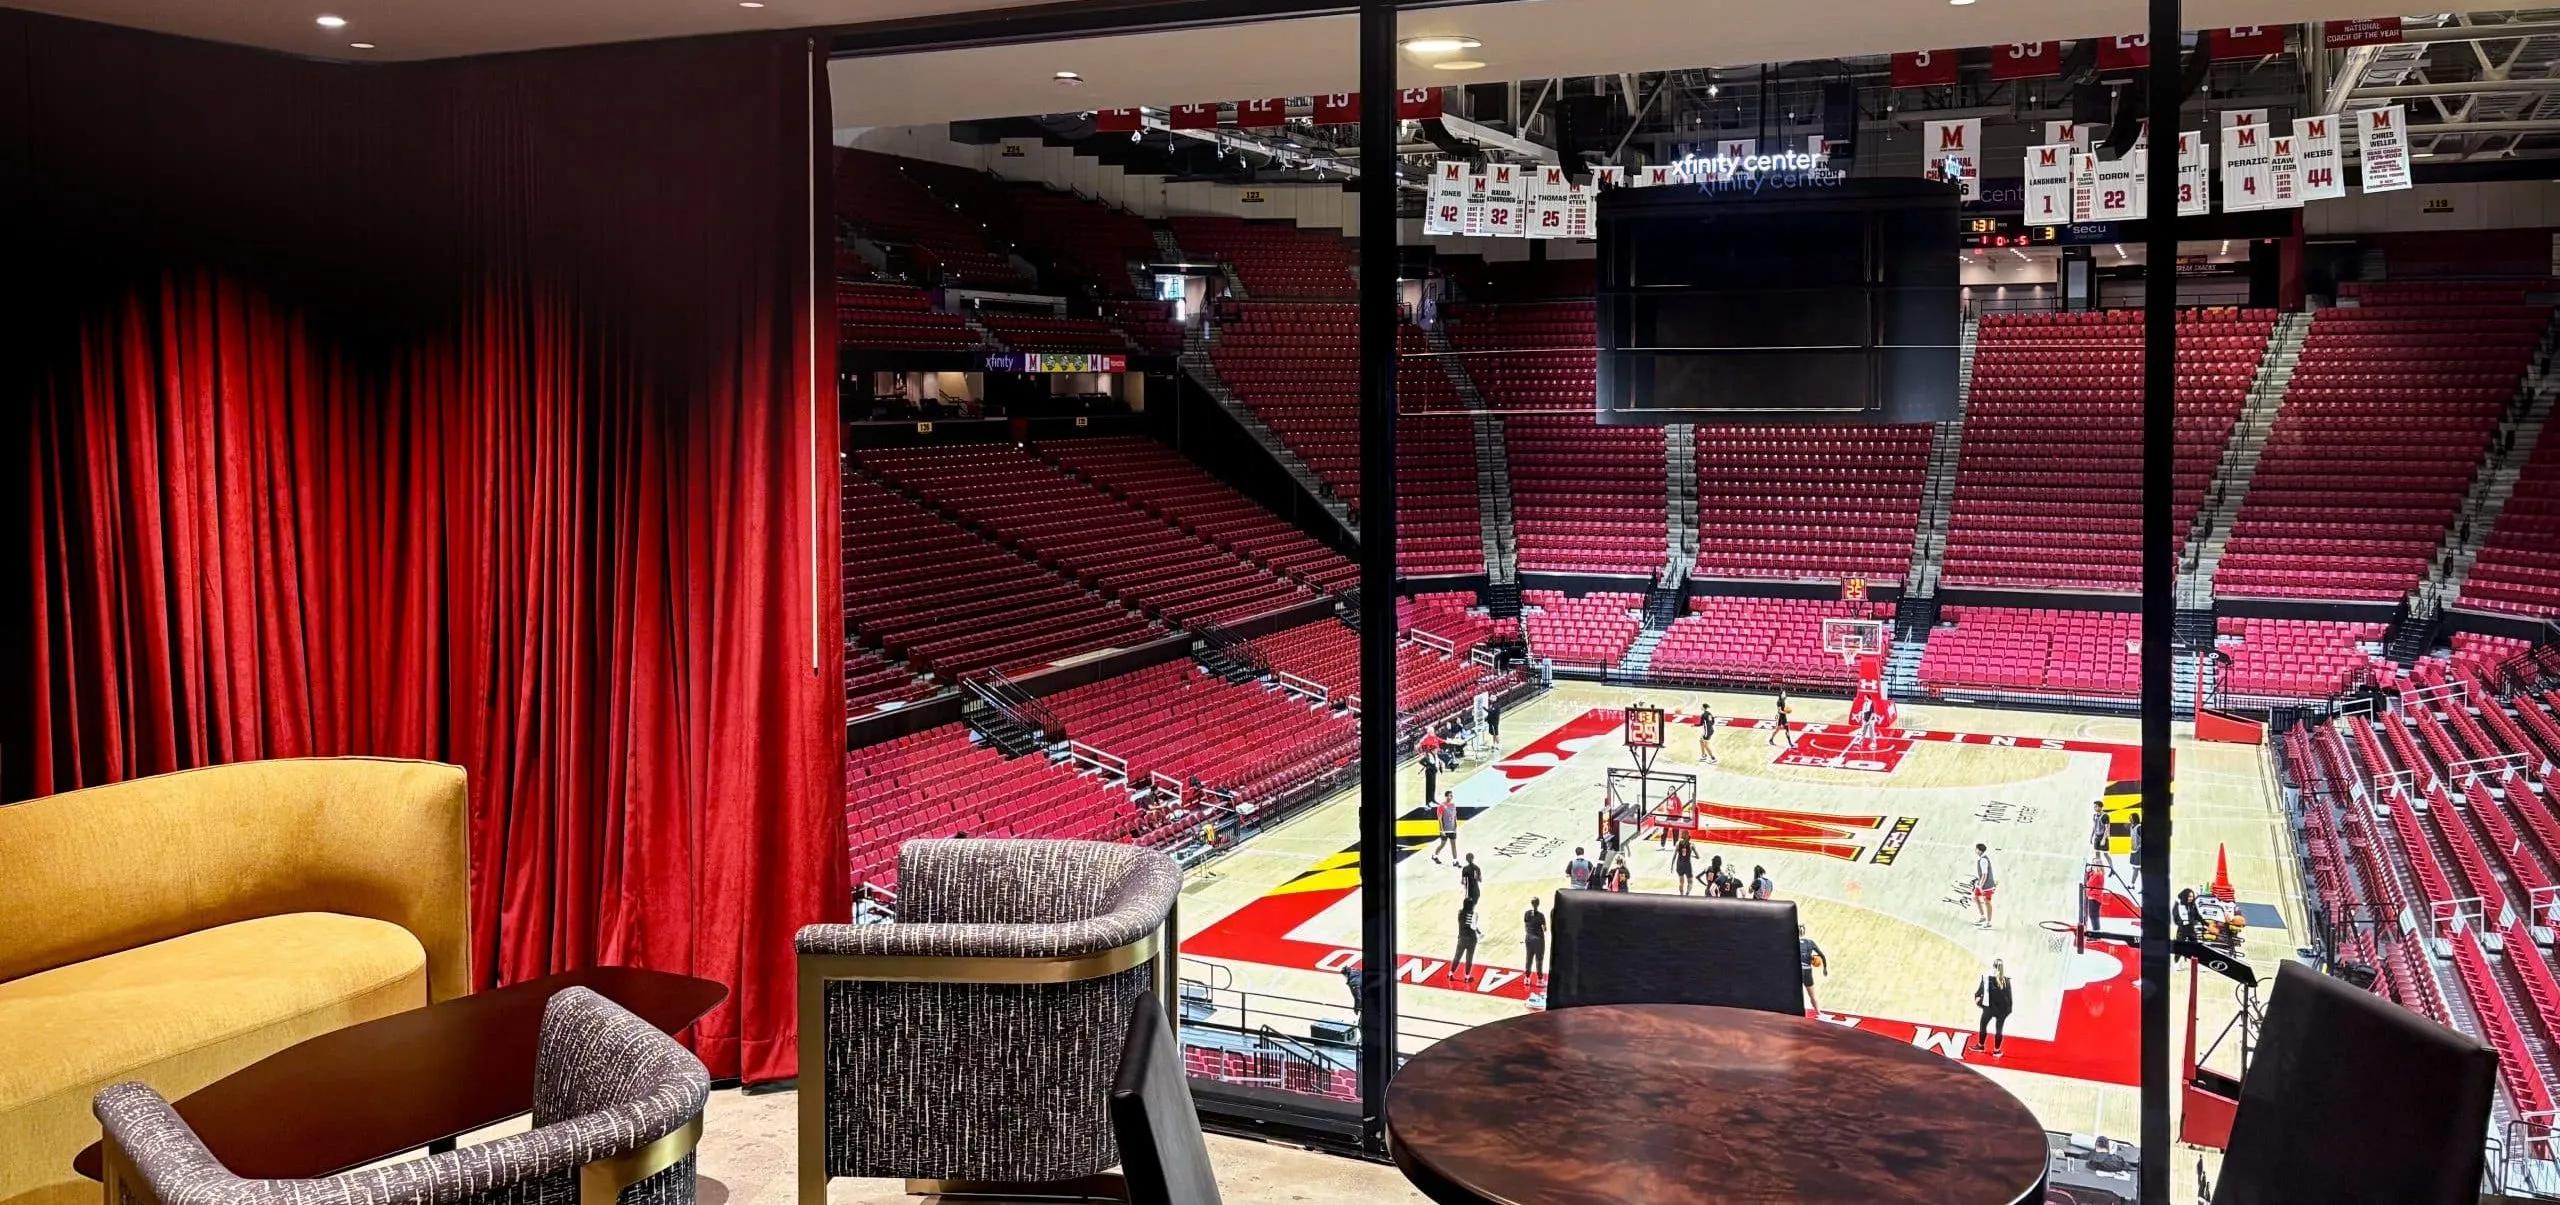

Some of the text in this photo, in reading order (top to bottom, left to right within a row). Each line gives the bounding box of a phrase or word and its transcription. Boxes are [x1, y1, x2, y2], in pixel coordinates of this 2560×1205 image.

[2380, 29, 2399, 37] YEAR
[2372, 110, 2391, 128] M
[2059, 125, 2074, 139] M
[2307, 120, 2326, 137] M
[1941, 125, 1964, 148] M
[2238, 129, 2255, 146] M
[2370, 139, 2397, 147] WELLER
[2371, 132, 2394, 140] CHRIS
[2274, 140, 2290, 154] M
[2303, 149, 2333, 159] HEISS
[2040, 149, 2056, 165] M
[2228, 157, 2269, 168] PERAZIC
[1447, 165, 1459, 179] M
[1672, 150, 1821, 180] xfinity center
[1497, 167, 1510, 181] M
[1547, 168, 1560, 182] M
[1653, 169, 1666, 183] M
[2099, 172, 2130, 181] DORON
[2307, 168, 2332, 187] 44
[2029, 177, 2067, 186] LANGHORNE
[2244, 177, 2256, 195] 4
[2043, 195, 2053, 213] 1
[2104, 190, 2126, 209] 22
[1441, 206, 1458, 222] 42
[1491, 208, 1508, 225] 32
[1542, 211, 1560, 227] 25
[1972, 220, 1994, 232] 1:31
[2045, 227, 2054, 239] 3
[2073, 224, 2107, 234] secu
[985, 353, 1014, 371] xfinity
[1847, 586, 1862, 598] 25
